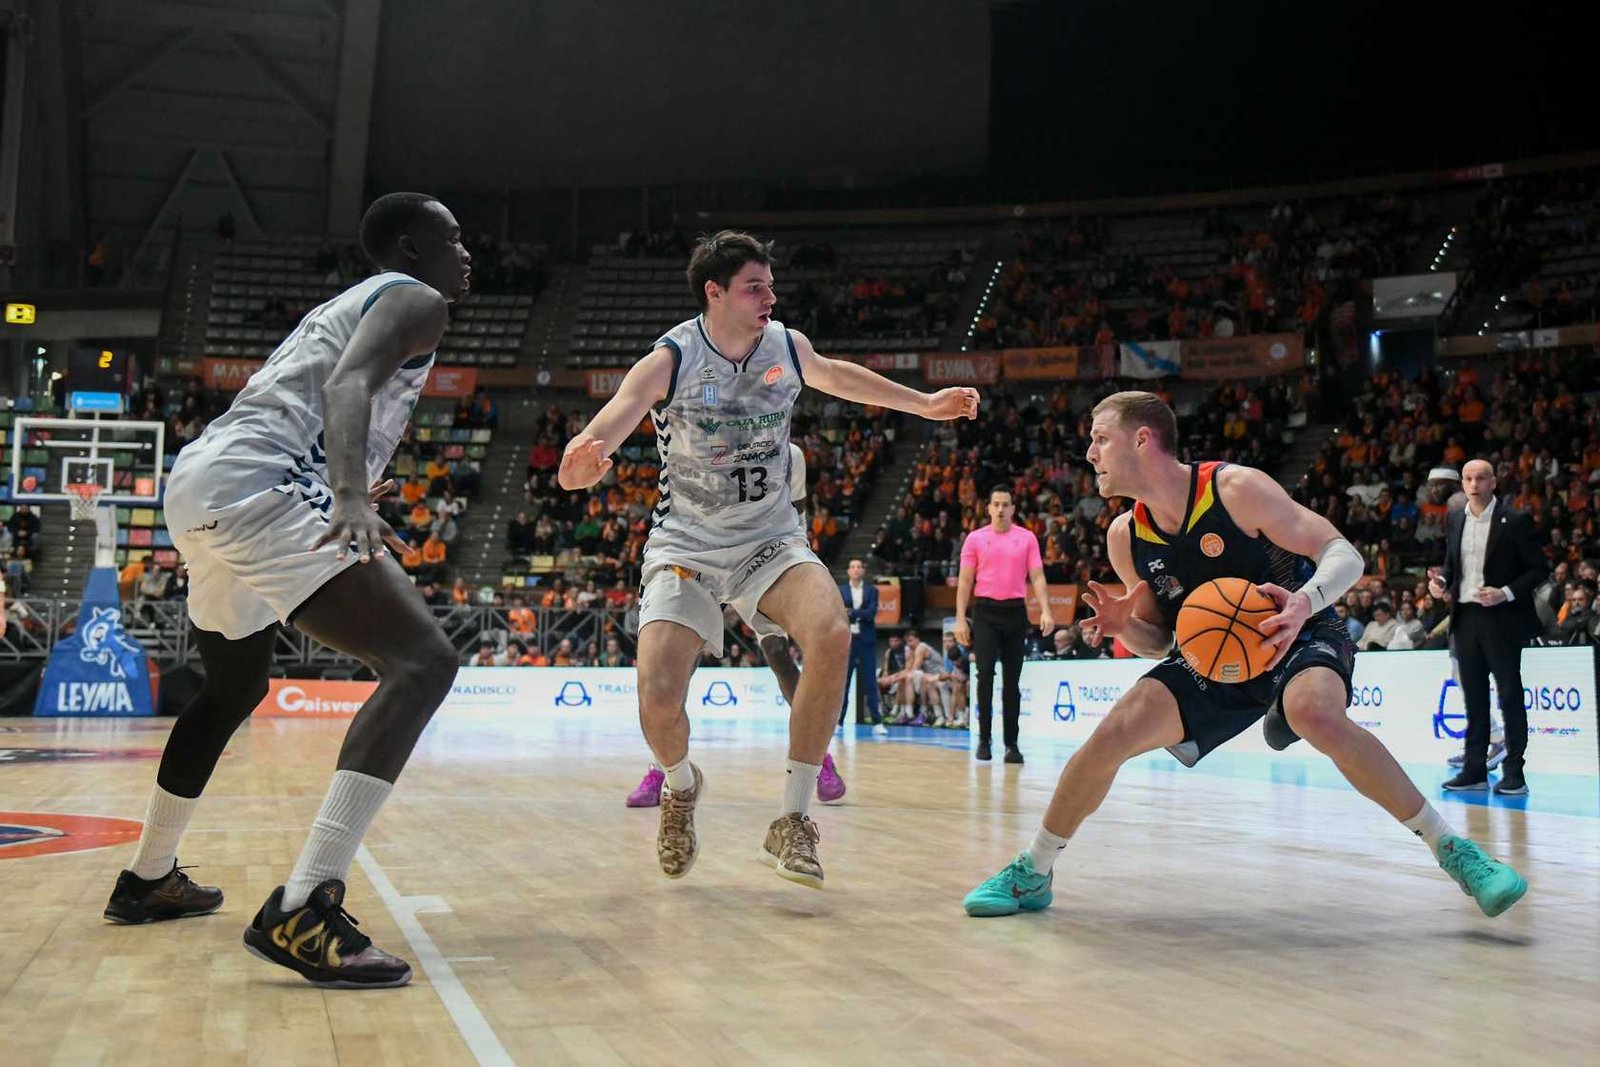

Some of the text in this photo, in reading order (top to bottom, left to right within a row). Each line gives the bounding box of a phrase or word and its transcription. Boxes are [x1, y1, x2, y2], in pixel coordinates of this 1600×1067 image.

[98, 350, 113, 368] 2
[730, 466, 768, 503] 13
[57, 682, 134, 712] LEYMA
[453, 685, 517, 695] RADISCO
